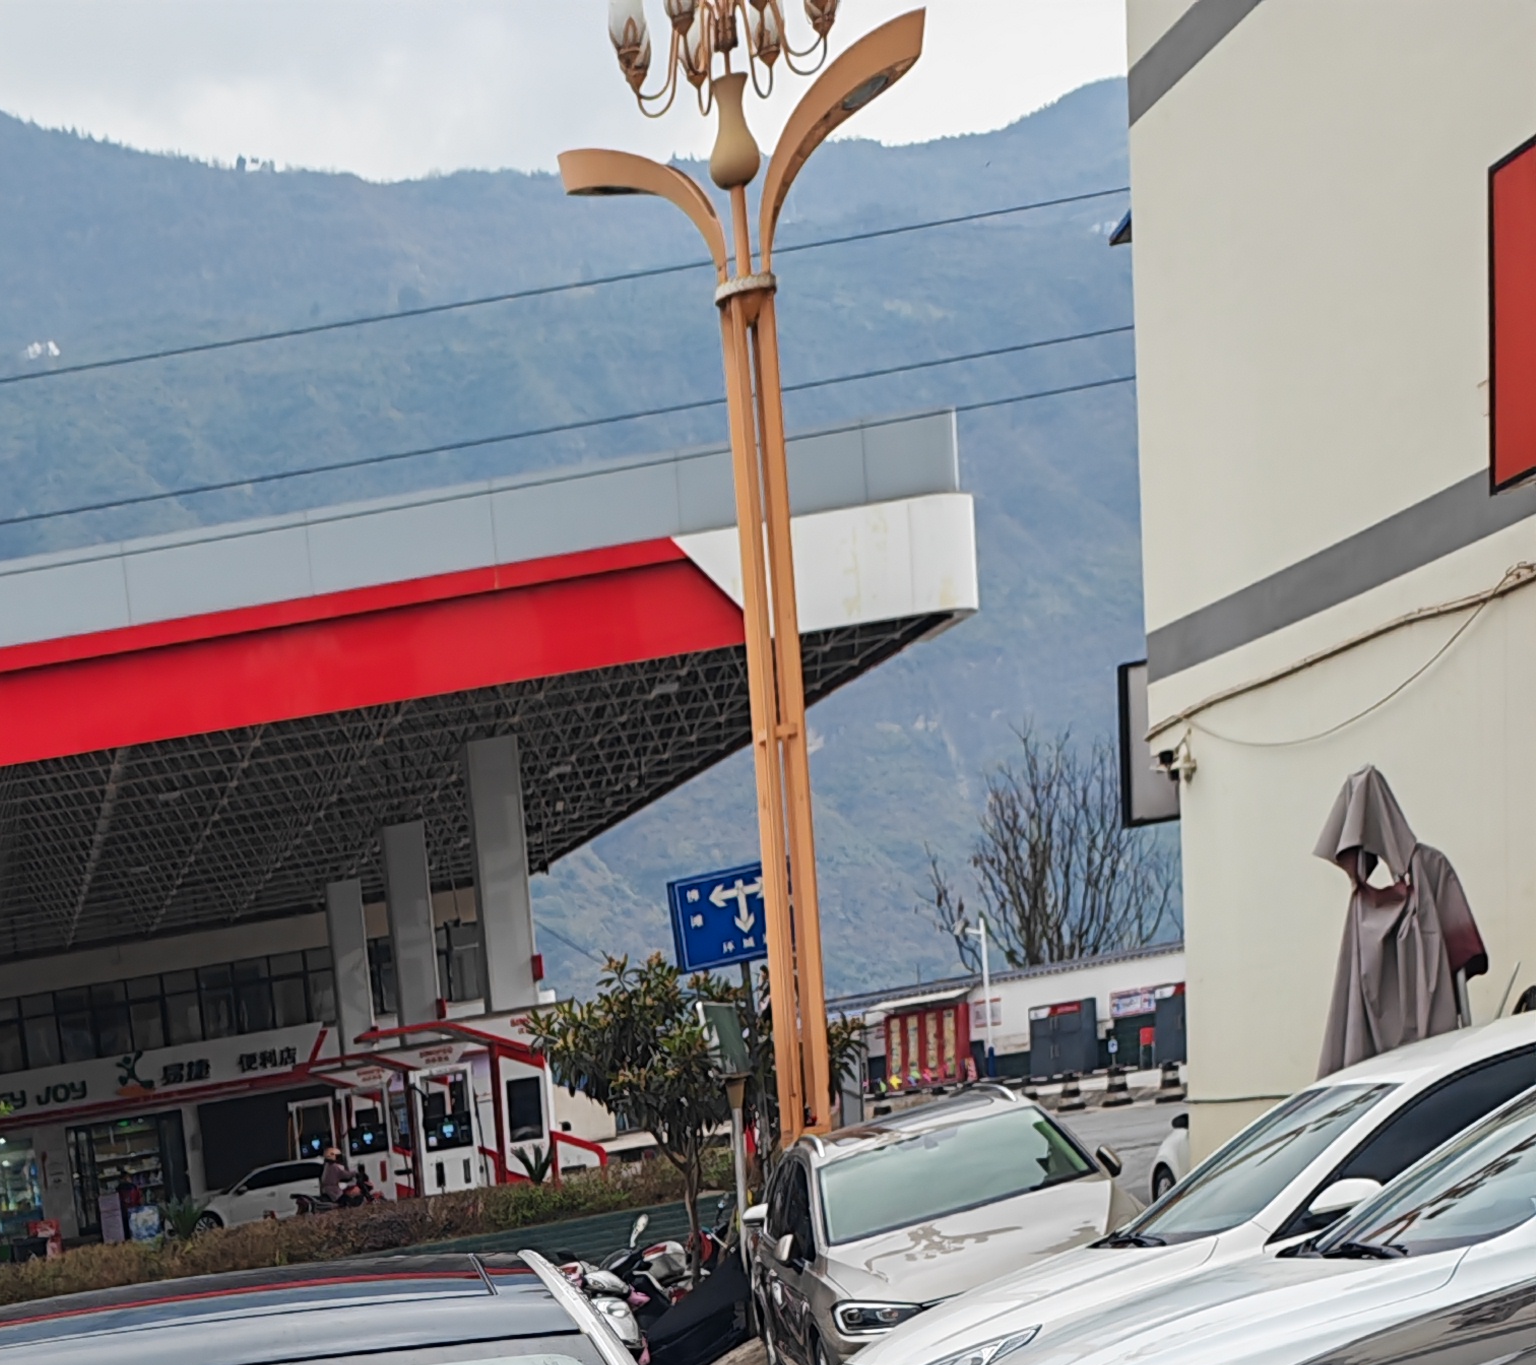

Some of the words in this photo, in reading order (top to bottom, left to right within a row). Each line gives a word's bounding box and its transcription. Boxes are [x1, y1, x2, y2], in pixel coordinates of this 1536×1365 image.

[237, 1046, 297, 1073] 便利店
[36, 1079, 87, 1106] JOY
